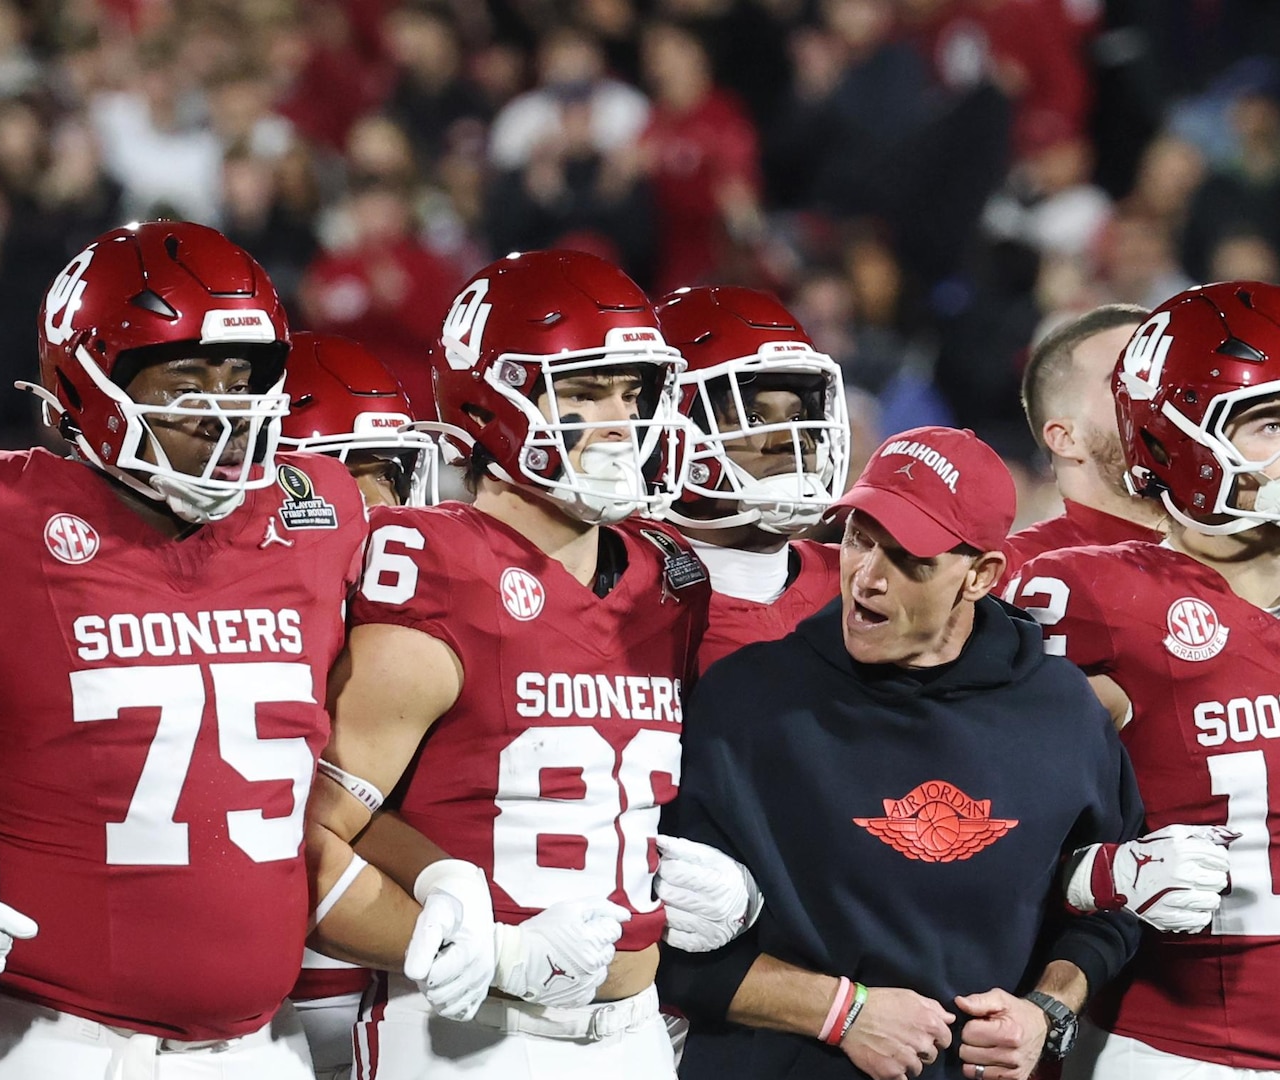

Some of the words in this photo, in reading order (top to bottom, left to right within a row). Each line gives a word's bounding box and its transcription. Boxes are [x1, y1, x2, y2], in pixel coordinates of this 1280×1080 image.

[880, 440, 960, 491] OKLAHOMA
[283, 509, 307, 518] FIRST
[307, 508, 332, 518] ROUND
[288, 500, 322, 510] PLAYOFF
[48, 515, 97, 561] SEC
[503, 570, 543, 618] SEC
[1005, 576, 1071, 656] 2
[73, 608, 304, 661] SOONERS
[1171, 599, 1216, 645] SEC
[1172, 636, 1224, 661] GRADUATE
[516, 672, 683, 723] SOONERS
[68, 661, 318, 866] 75
[891, 795, 920, 817] AIR
[919, 783, 985, 817] JORDAN
